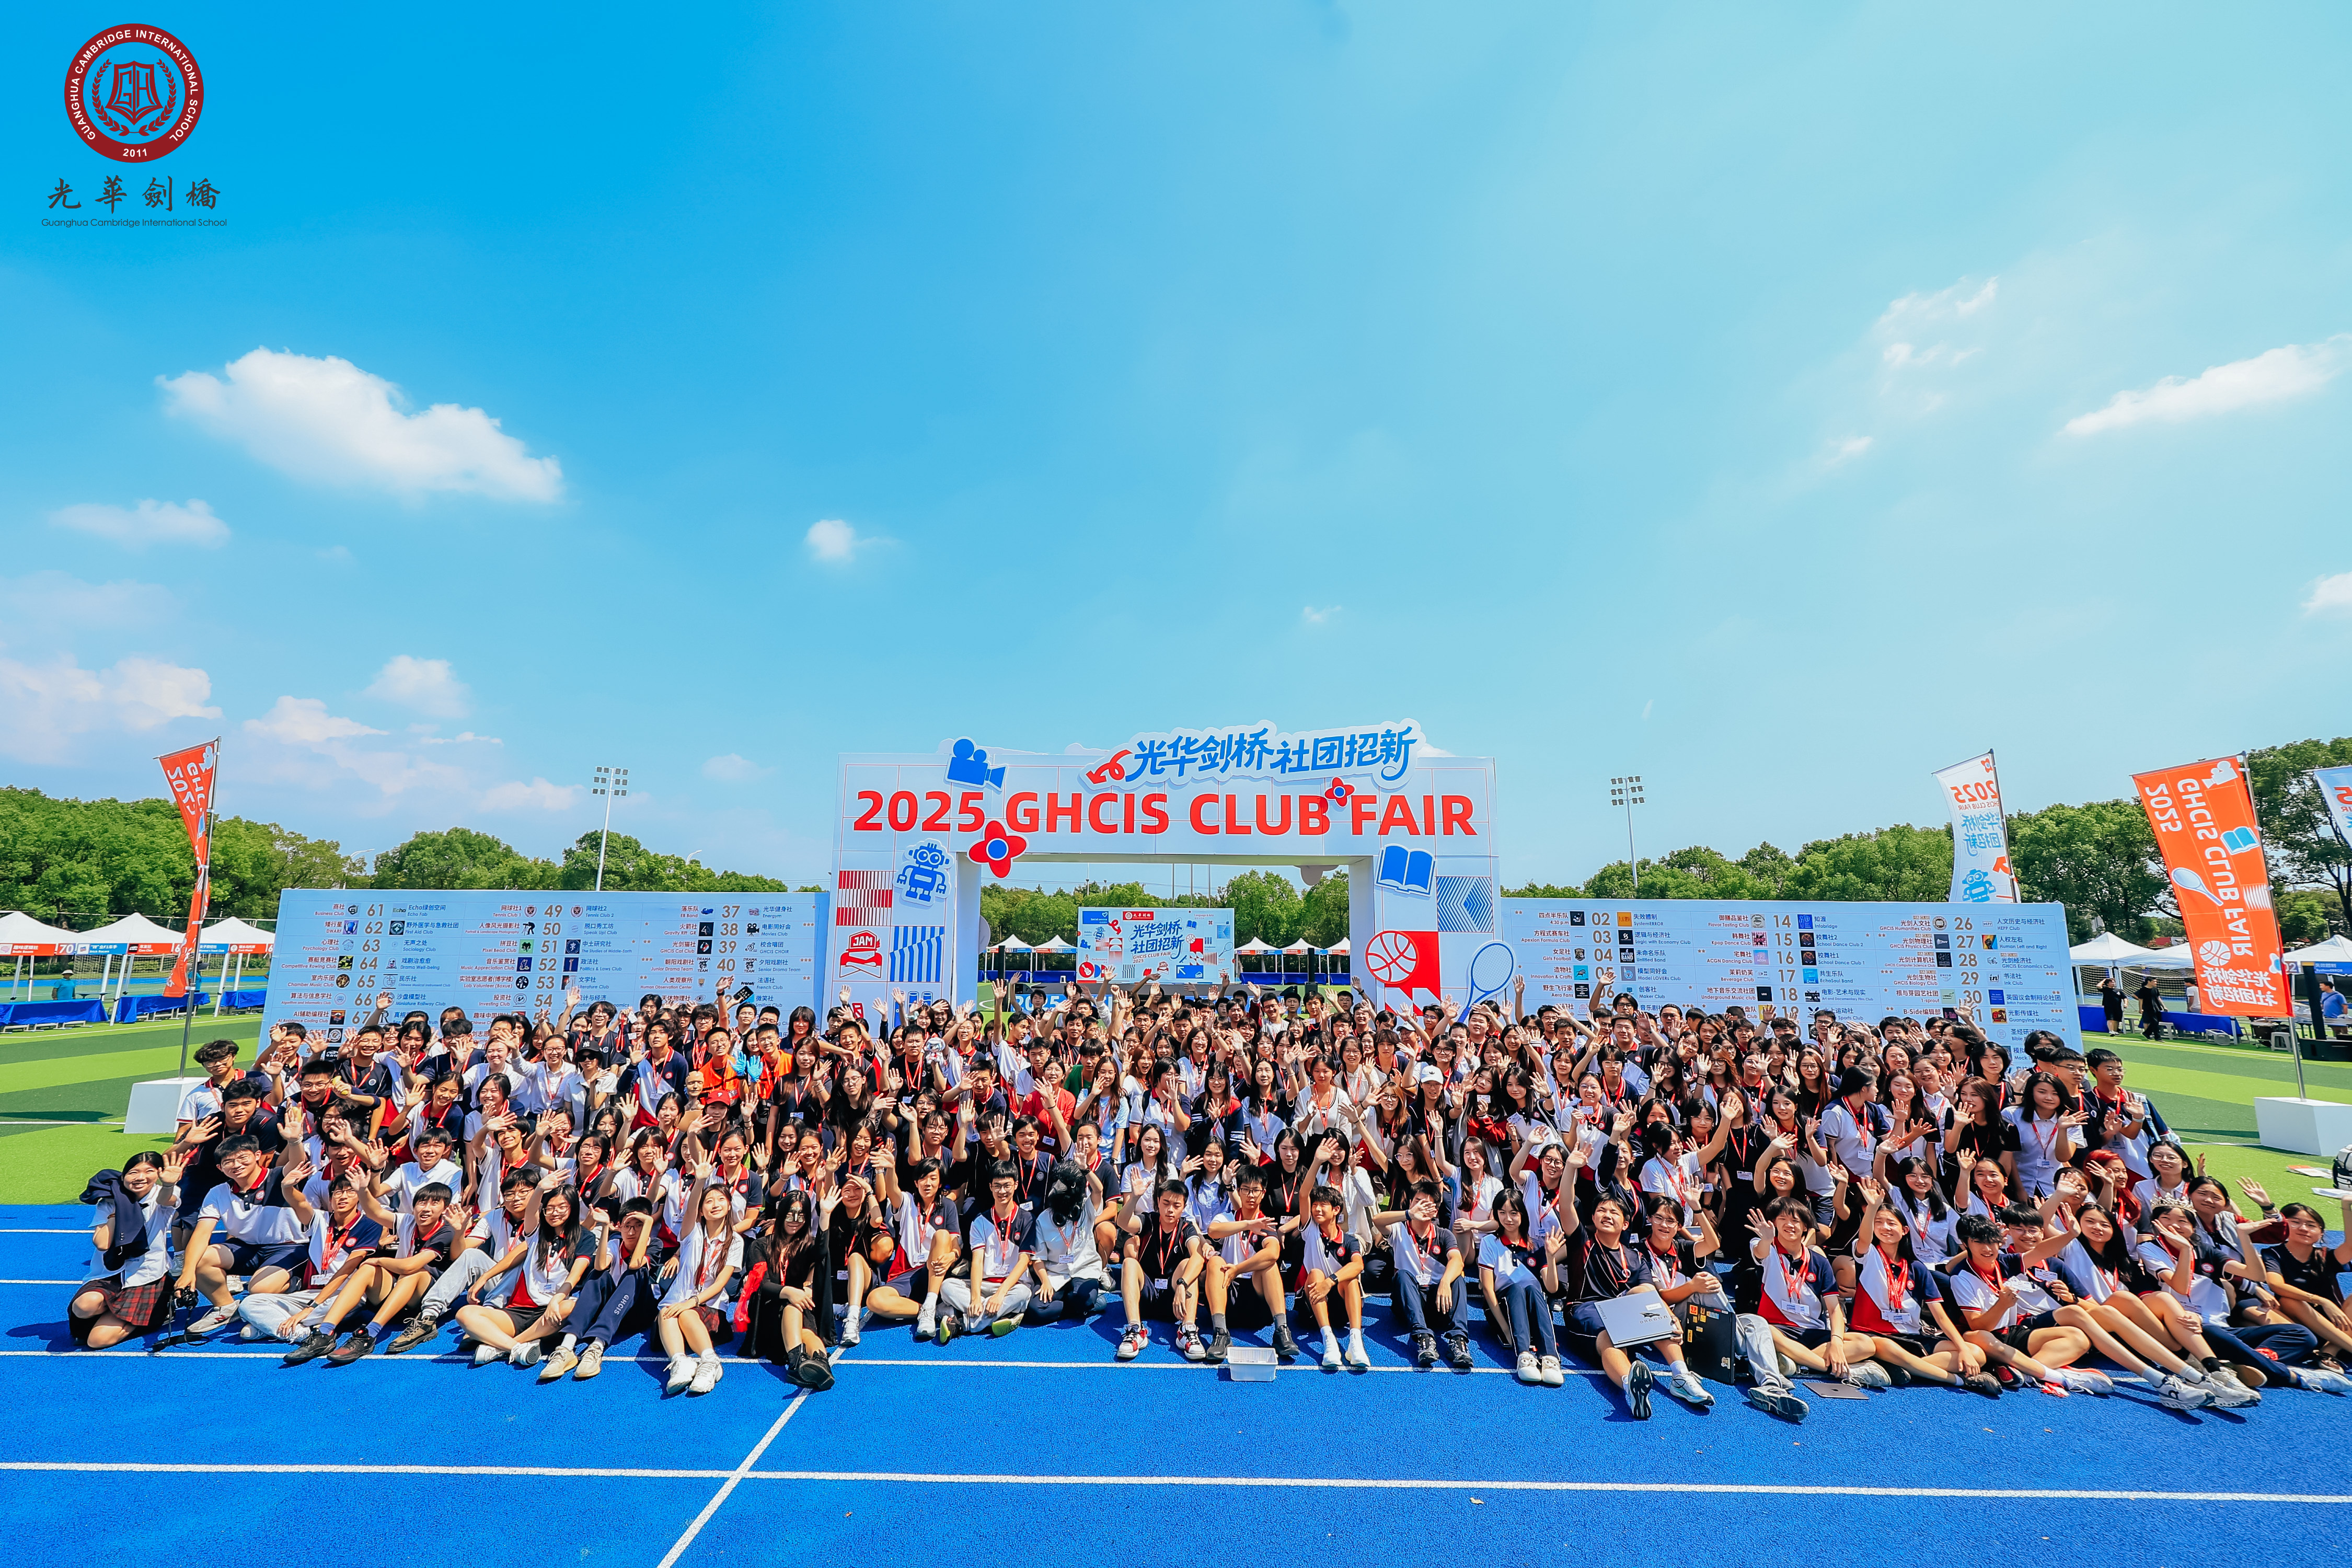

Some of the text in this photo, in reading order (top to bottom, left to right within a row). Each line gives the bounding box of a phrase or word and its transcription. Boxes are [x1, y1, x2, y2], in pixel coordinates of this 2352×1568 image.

[855, 790, 1477, 836] 2025 GHCIS CLUB FAIR
[367, 904, 383, 916] 61
[544, 905, 562, 917] 49
[722, 905, 740, 918] 37
[1592, 913, 1610, 925] 02
[1773, 915, 1791, 928] 14
[1955, 917, 1973, 930] 26
[365, 921, 383, 934] 62
[543, 923, 560, 935] 50
[720, 923, 738, 936] 38
[1130, 919, 1183, 940] 光华剑桥
[853, 936, 873, 946] JAM
[1593, 930, 1611, 943] 03
[1775, 933, 1792, 946] 15
[1957, 935, 1974, 948] 27
[59, 944, 74, 954] 70
[363, 939, 380, 952] 63
[541, 941, 557, 953] 51
[719, 941, 736, 953] 39
[1131, 935, 1185, 959] 社团招新
[1595, 949, 1612, 961] 04
[1777, 951, 1794, 964] 16
[1959, 953, 1977, 966] 28
[360, 957, 377, 970] 64
[538, 958, 557, 971] 52
[717, 959, 735, 971] 40
[358, 975, 375, 988] 65
[536, 976, 554, 989] 53
[1778, 970, 1795, 982] 17
[1961, 972, 1978, 985] 29
[355, 993, 372, 1006] 66
[534, 994, 552, 1007] 54
[1780, 988, 1797, 1001] 18
[352, 1011, 371, 1024] 67
[614, 1295, 629, 1315] GHCIS
[1598, 1305, 1607, 1320] LEGION
